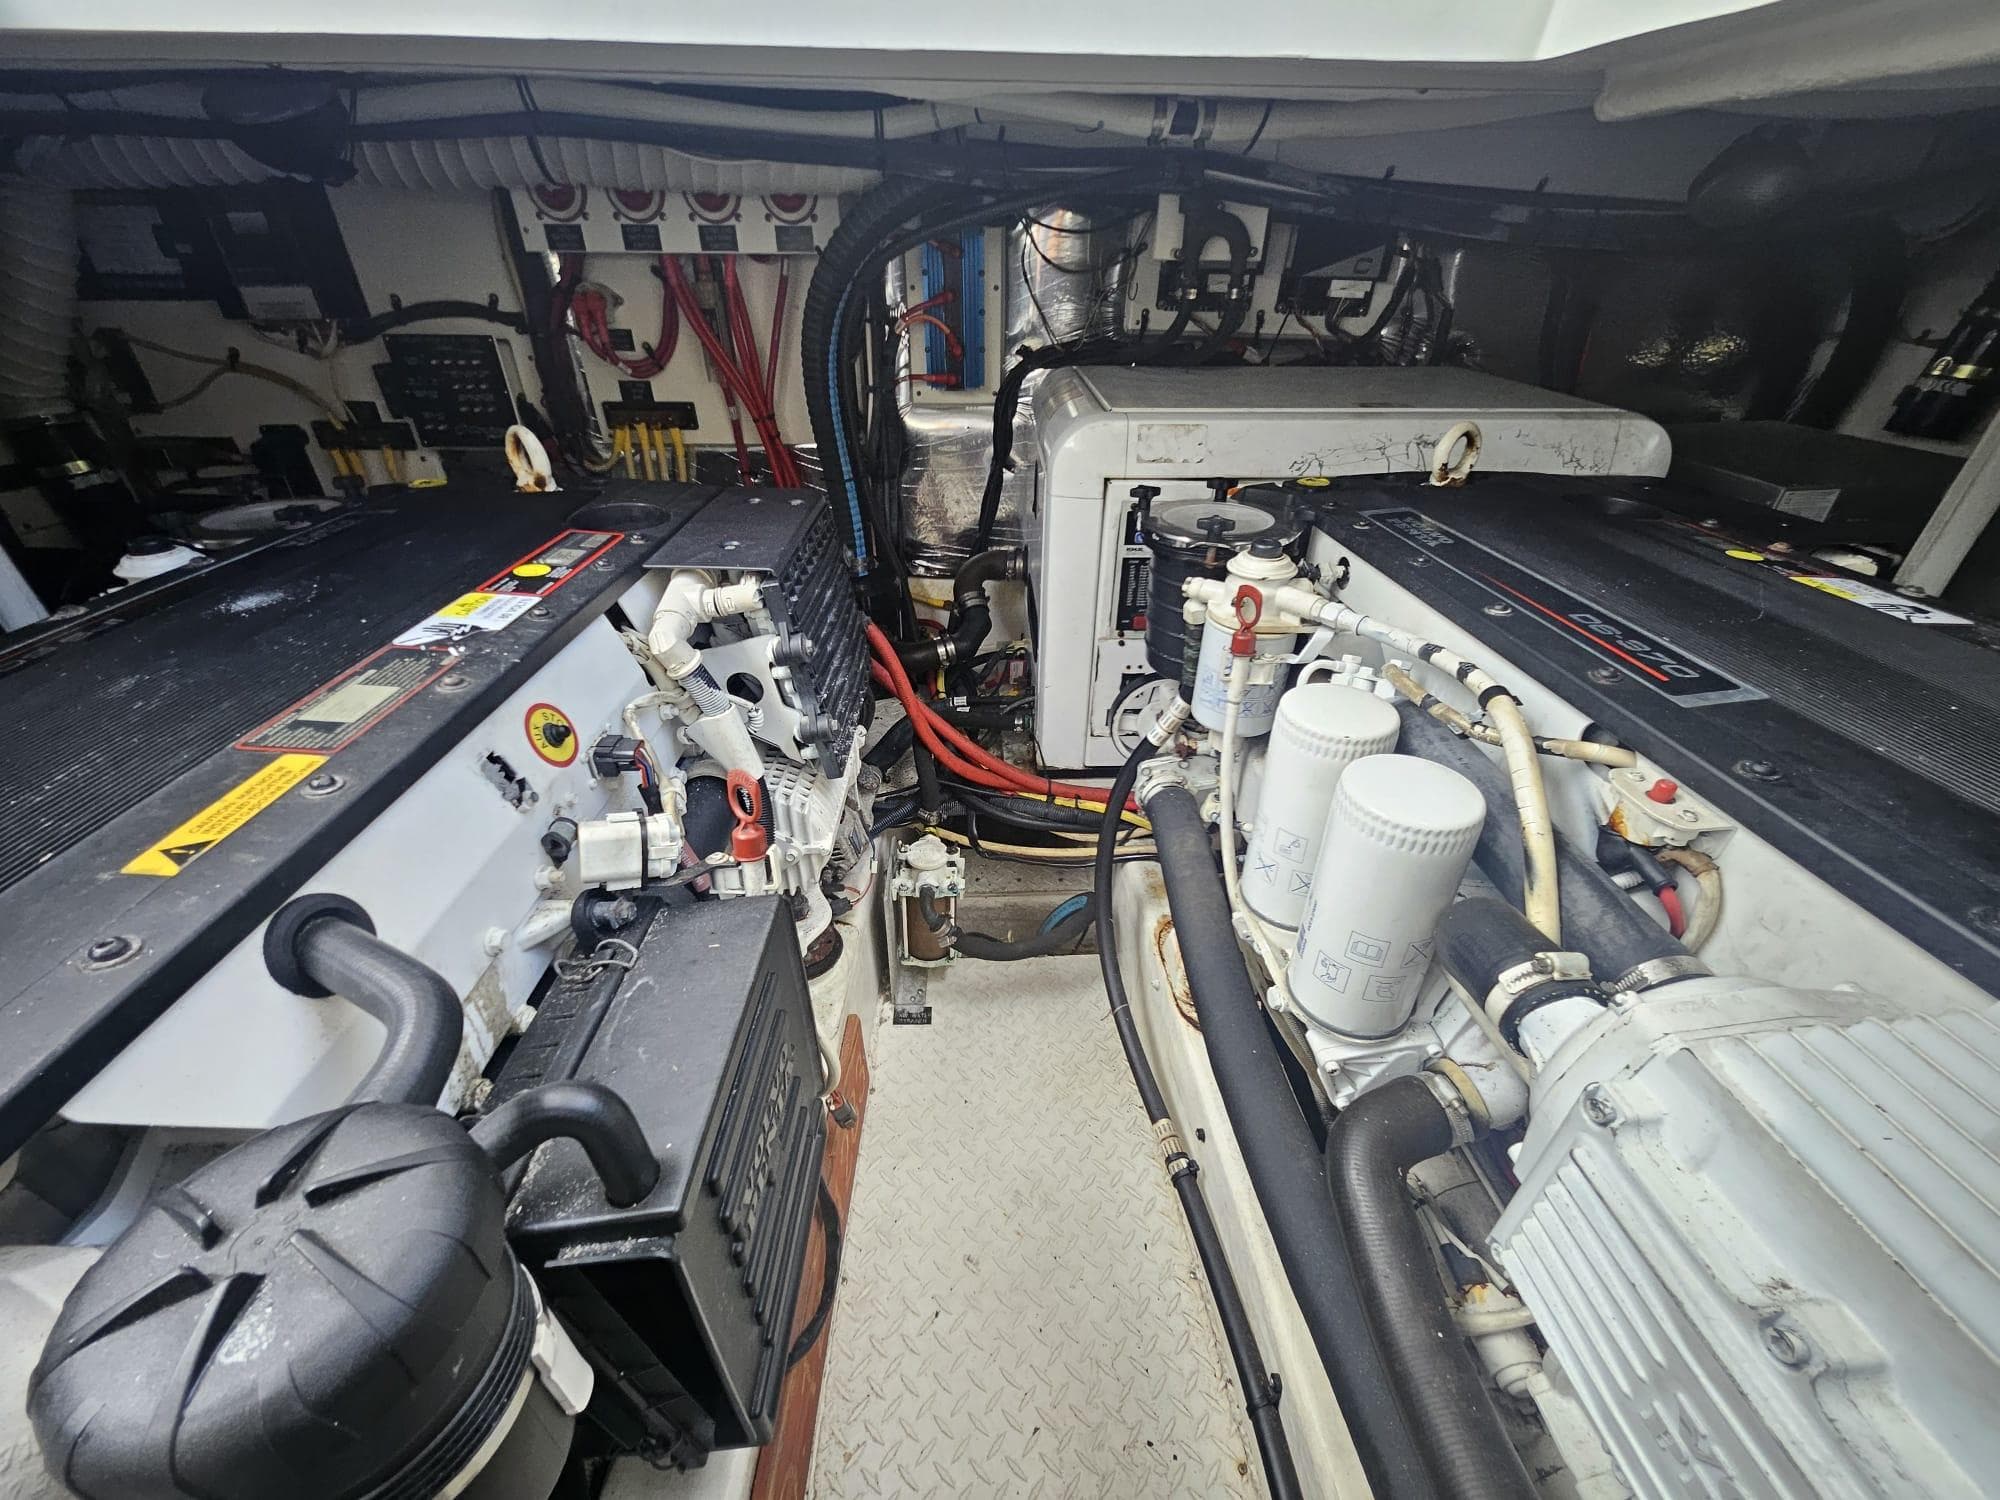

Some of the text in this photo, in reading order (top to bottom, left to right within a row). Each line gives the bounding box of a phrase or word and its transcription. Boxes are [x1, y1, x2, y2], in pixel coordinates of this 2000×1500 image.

[1568, 613, 1700, 677] D6-370
[532, 724, 549, 750] AUX
[742, 1041, 790, 1206] VOLVO
[744, 1059, 795, 1232] PENTA
